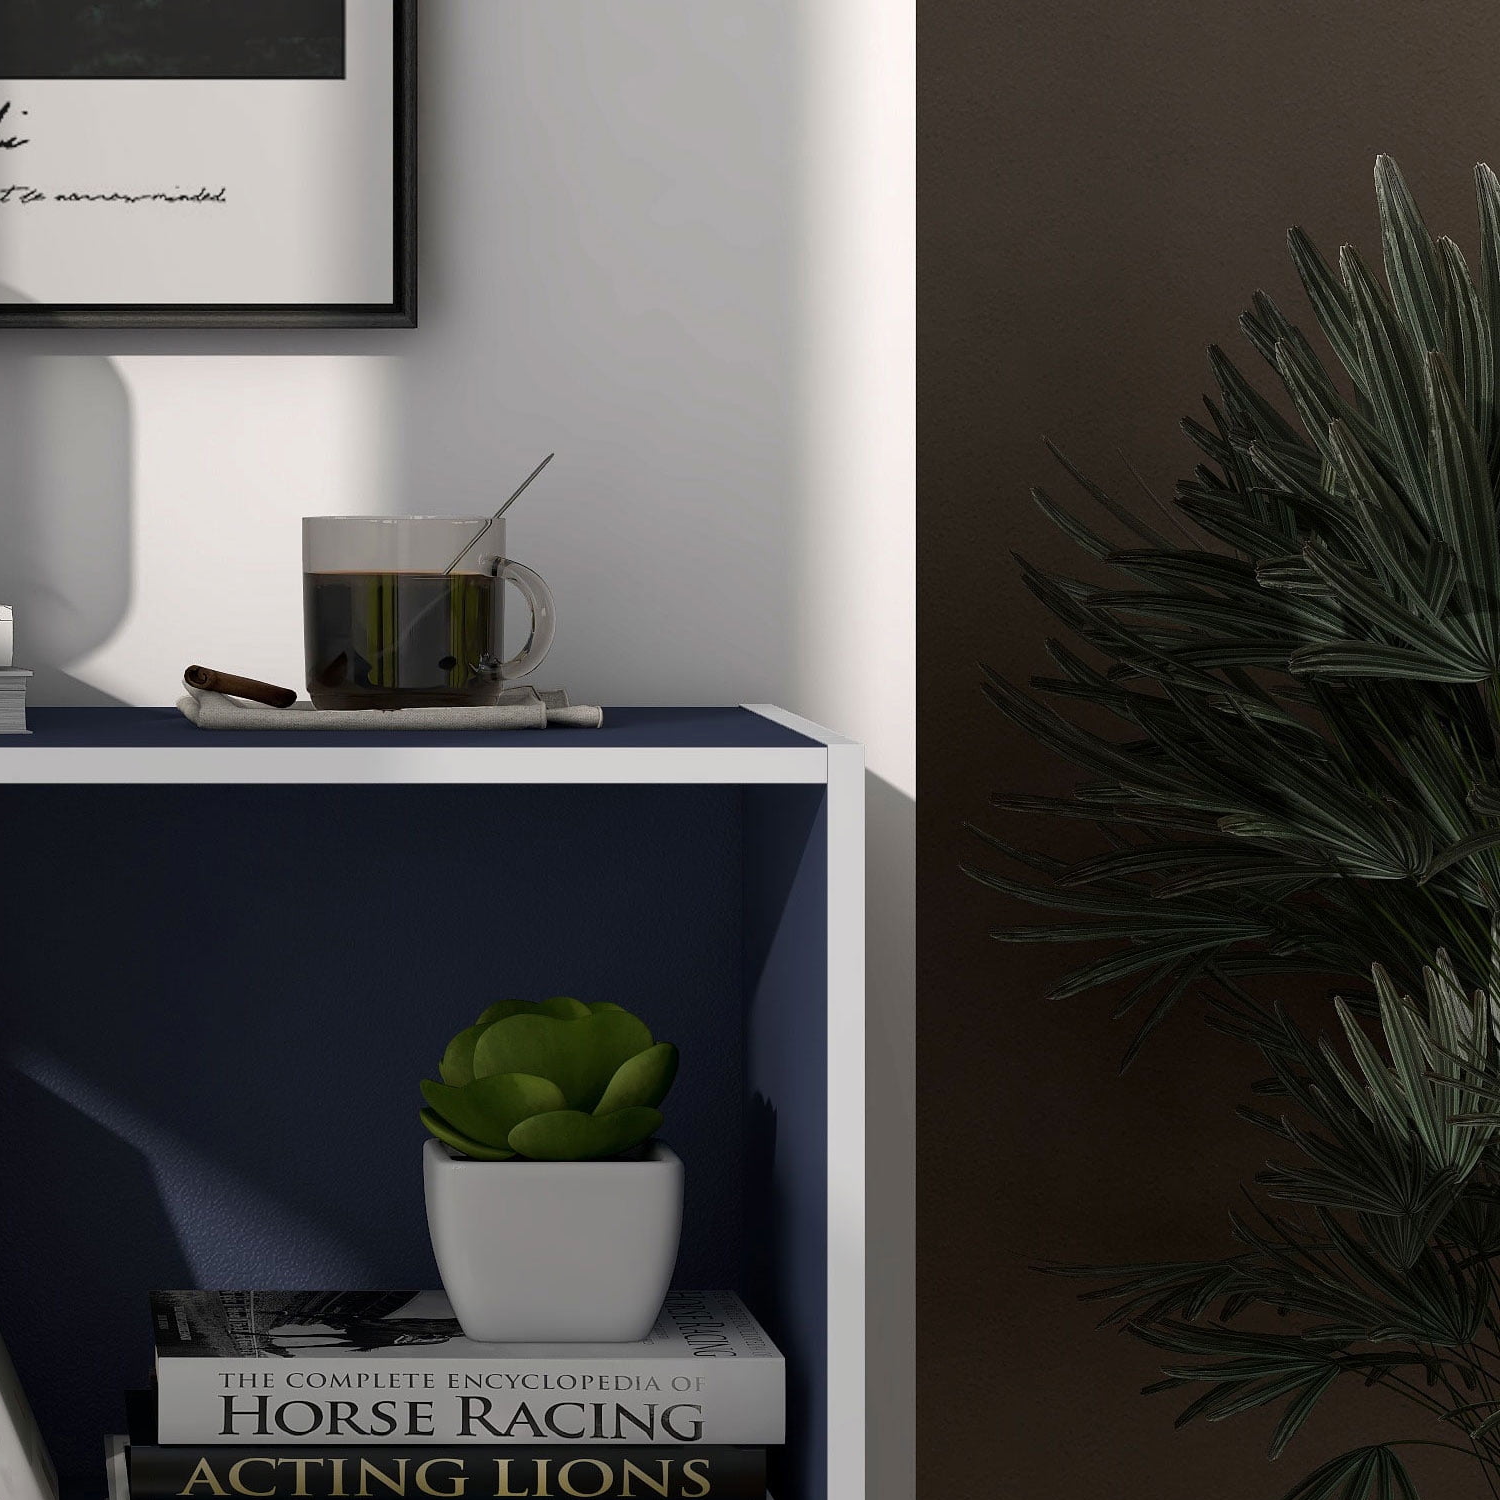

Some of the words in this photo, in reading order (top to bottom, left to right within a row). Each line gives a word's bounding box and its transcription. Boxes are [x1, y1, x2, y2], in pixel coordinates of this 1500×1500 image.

[218, 1372, 275, 1389] THE
[285, 1371, 436, 1389] COMPLETE
[447, 1372, 660, 1392] ENCYCLOPEDIA
[670, 1375, 706, 1393] OF
[217, 1394, 435, 1438] HORSE
[455, 1395, 706, 1442] RACING
[176, 1456, 470, 1498] ACTING
[492, 1457, 713, 1499] LIONS
